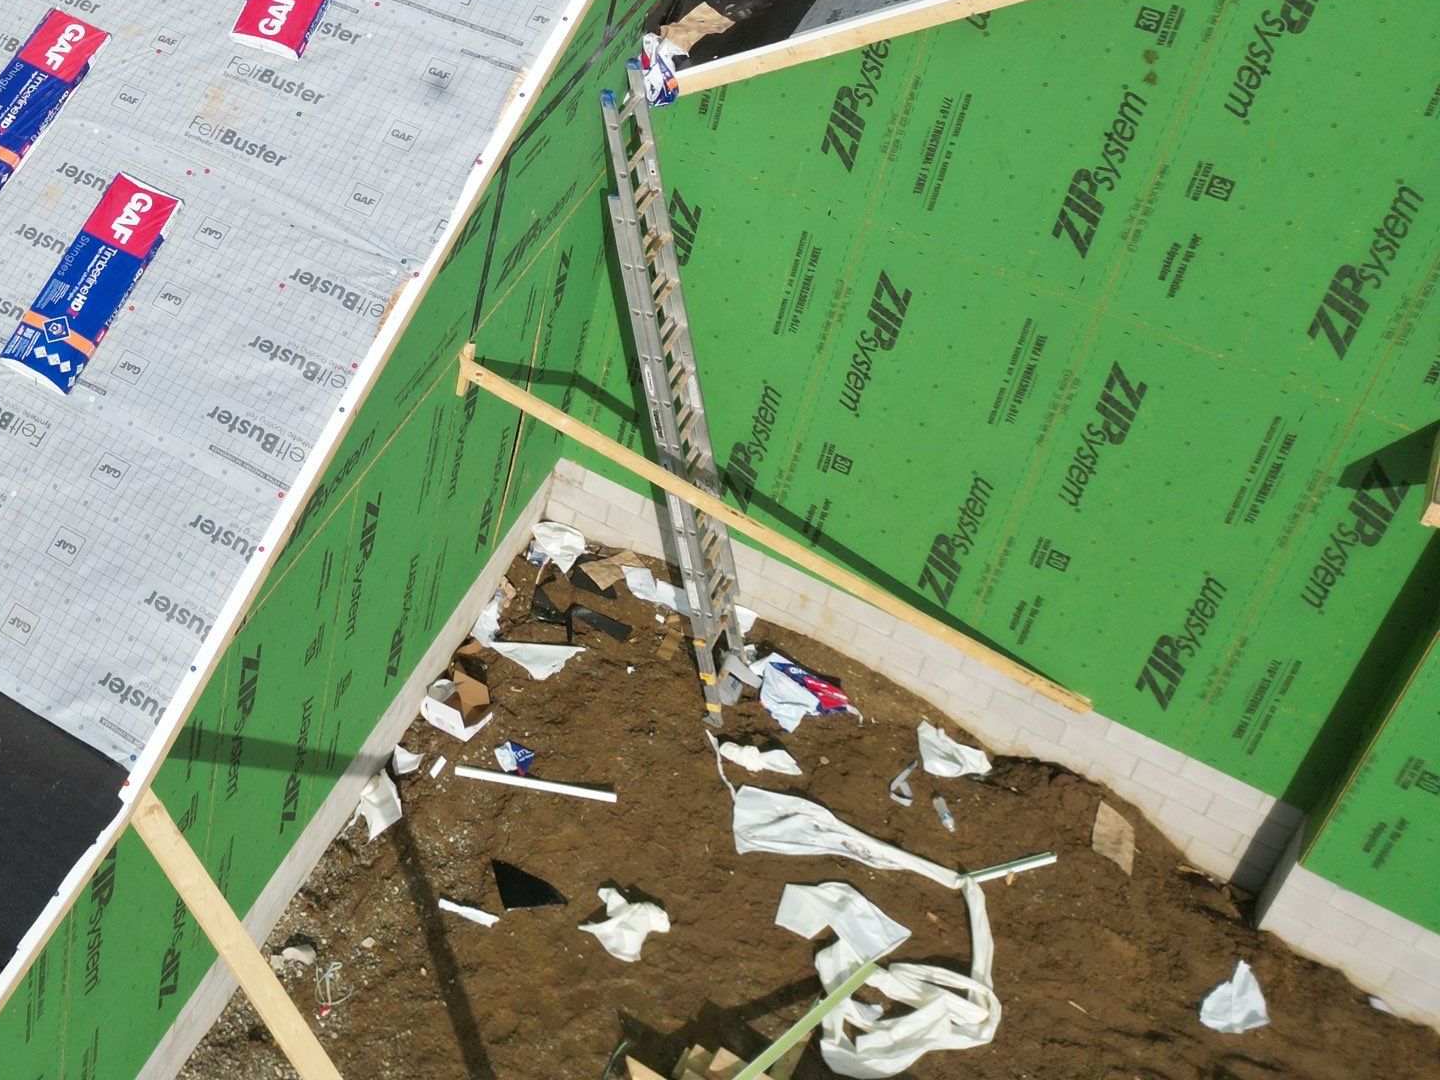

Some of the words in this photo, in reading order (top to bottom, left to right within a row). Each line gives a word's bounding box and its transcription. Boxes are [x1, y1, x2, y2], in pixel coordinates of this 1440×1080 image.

[43, 22, 85, 70] GAF
[1139, 8, 1160, 32] 30
[1164, 4, 1179, 30] SYSTEM
[0, 71, 48, 129] TimberlineHD
[820, 38, 893, 174] ZIPsyste
[188, 115, 287, 167] FeltBuster
[923, 120, 947, 168] STRUCTURAL
[1051, 91, 1148, 259] ZIPsystem
[111, 191, 154, 245] GAF
[353, 191, 375, 205] GAF
[913, 174, 928, 195] PANEL
[1210, 177, 1232, 200] 30
[57, 235, 90, 277] Shingles
[1188, 233, 1202, 250] Join
[1307, 186, 1425, 361] ZIPsystem
[70, 245, 118, 312] TimberlineHD
[794, 276, 814, 314] STRUCTURAL
[811, 246, 822, 264] PANEL
[839, 270, 912, 414] ZIPsystem
[1016, 363, 1037, 405] STRUCTURAL
[1034, 334, 1048, 356] PANEL
[718, 385, 782, 514] ZIPsystem
[1058, 360, 1148, 507] ZIPsystem
[475, 425, 510, 555] ZIPsystem
[345, 491, 383, 641] ZIPsystem
[917, 476, 994, 609] ZIPsystem
[1300, 457, 1410, 609] ZIPsystem
[8, 615, 32, 634] GAF
[383, 553, 421, 688] ZIPsystem
[1134, 575, 1228, 712] ZIPsystem
[225, 642, 262, 802] ZIPsystem
[279, 696, 314, 836] ZIPsystem
